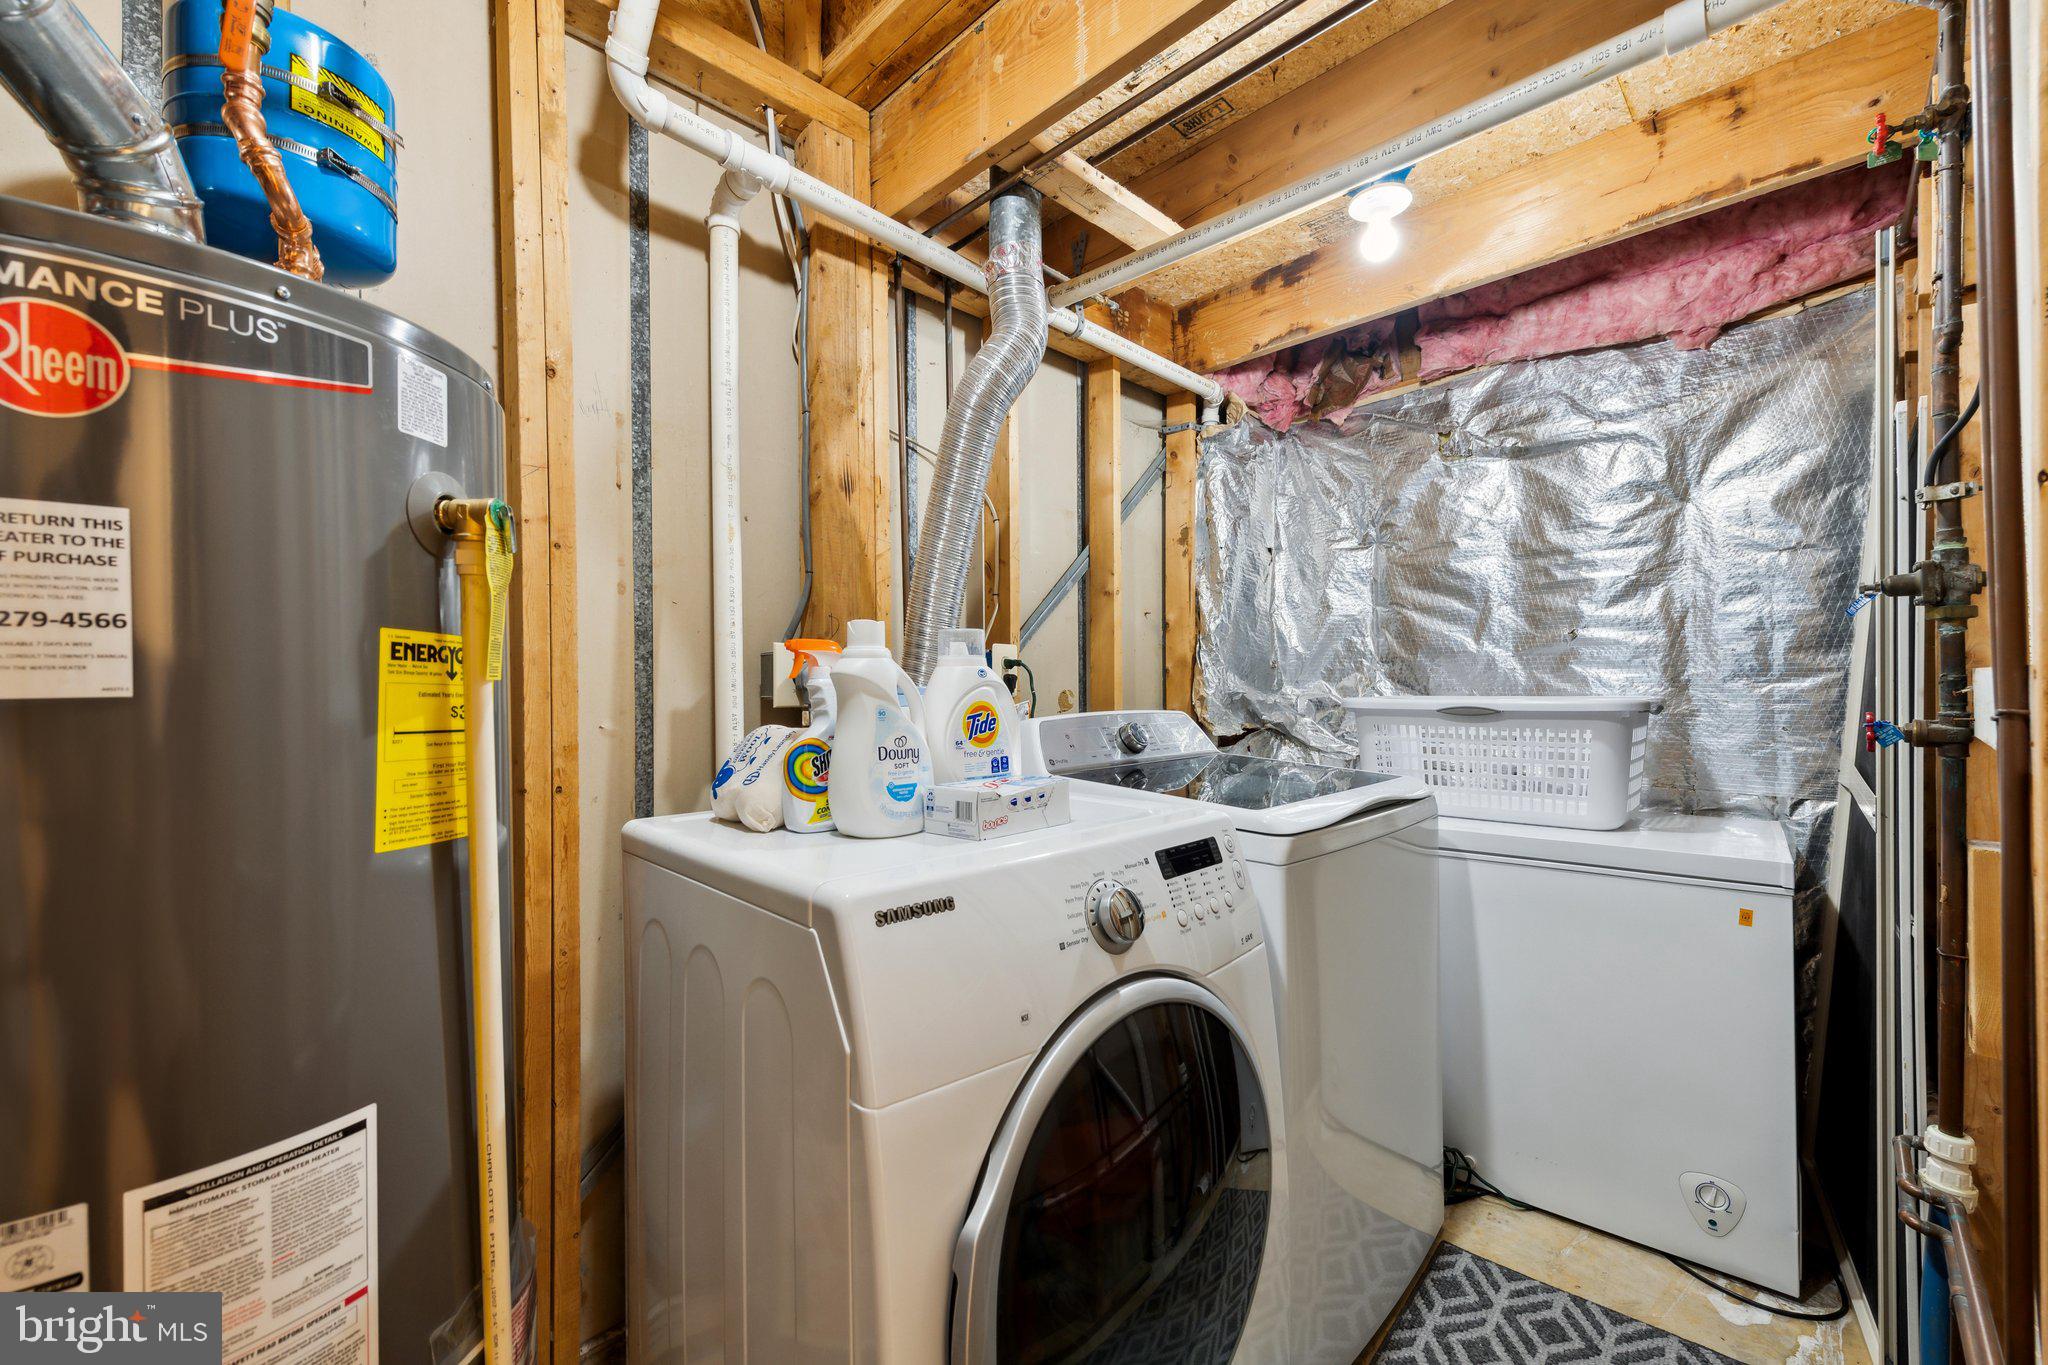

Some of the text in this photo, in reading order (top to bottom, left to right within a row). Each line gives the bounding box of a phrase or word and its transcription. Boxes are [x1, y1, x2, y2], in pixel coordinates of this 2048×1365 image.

[1614, 38, 1633, 53] IPS
[1589, 48, 1612, 64] SCH
[1569, 60, 1585, 73] 40
[1540, 68, 1568, 85] COEX
[1182, 108, 1214, 131] SHIFT
[1464, 102, 1489, 119] CORE
[1403, 132, 1423, 147] PIPE
[1379, 142, 1401, 156] ASTM
[1282, 178, 1321, 199] CHARLOTTE
[1265, 195, 1281, 207] PIPE
[180, 297, 279, 344] PLUS
[0, 302, 117, 396] Rheem
[0, 512, 123, 531] RETURN THIS
[59, 534, 86, 546] TO
[90, 536, 125, 549] THE
[14, 550, 117, 566] PURCHASE
[0, 610, 127, 629] 279-4566
[966, 712, 997, 741] Tide
[878, 746, 920, 764] Downy
[964, 750, 979, 759] free
[874, 896, 956, 927] SAMSUNG
[245, 1163, 266, 1176] AND
[267, 1144, 312, 1167] OPERATION
[313, 1131, 344, 1150] DETAILS
[241, 1171, 281, 1191] STORAGE
[283, 1159, 310, 1175] WATER
[311, 1147, 340, 1163] HEATER
[485, 1143, 495, 1223] CHARLOTTE
